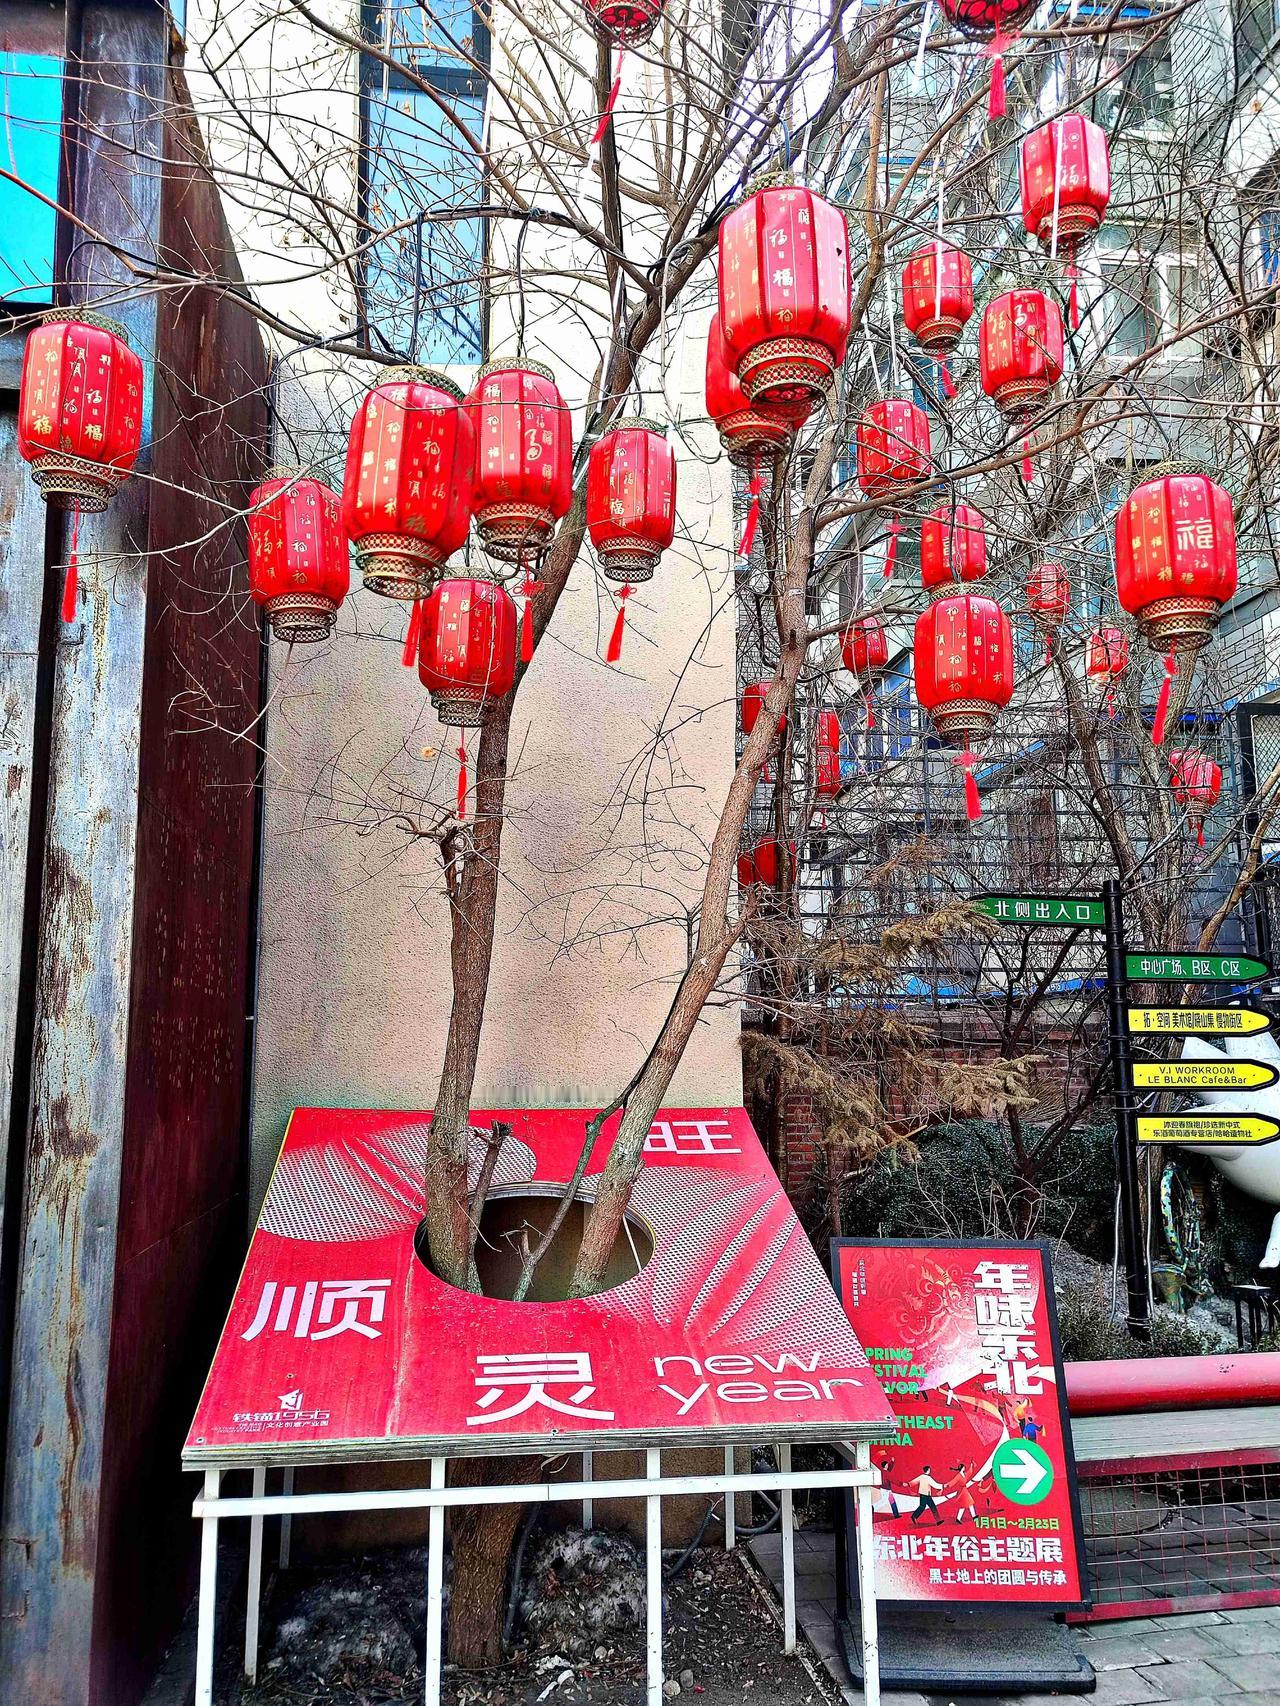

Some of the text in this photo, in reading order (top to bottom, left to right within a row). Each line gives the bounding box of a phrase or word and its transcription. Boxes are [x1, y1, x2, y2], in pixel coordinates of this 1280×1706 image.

[773, 268, 793, 287] 福
[1175, 517, 1214, 551] 福
[994, 901, 1090, 920] 北侧出入口
[1148, 1075, 1247, 1084] LE BLANC Cafe&Bar
[1175, 1066, 1235, 1075] WORKROOM
[643, 1120, 743, 1154] 旺
[240, 1279, 392, 1341] 顺
[972, 1261, 1044, 1395] 年味东北
[653, 1351, 822, 1377] new
[866, 1347, 914, 1361] PRING
[873, 1364, 928, 1378] STIVAL
[466, 1352, 615, 1426] 灵
[657, 1377, 864, 1415] year
[897, 1415, 954, 1430] THEAST
[874, 1535, 1063, 1562] 东北年俗主题展
[929, 1568, 1068, 1586] 黑土地上的团圆与传承
